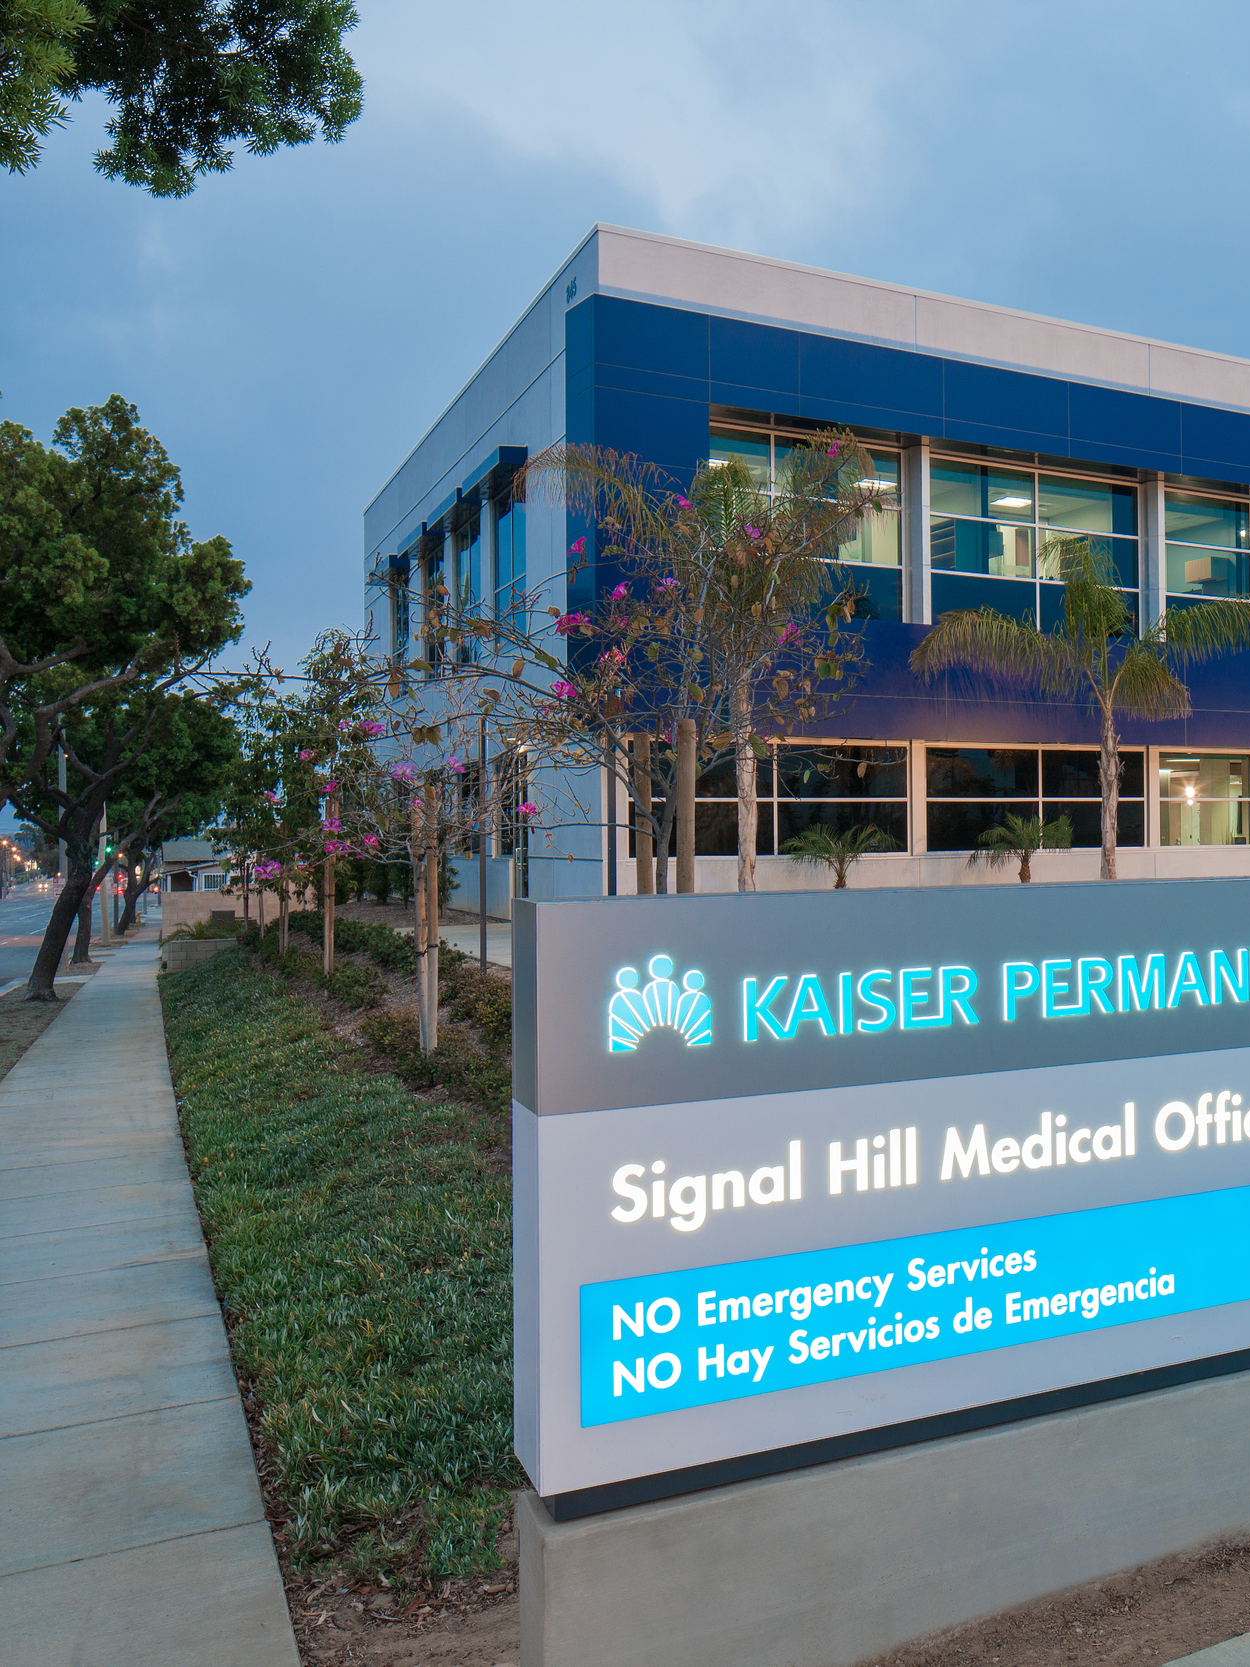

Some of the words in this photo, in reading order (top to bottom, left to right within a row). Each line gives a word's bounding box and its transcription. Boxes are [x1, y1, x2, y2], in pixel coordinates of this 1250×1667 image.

[566, 275, 577, 304] 845
[742, 964, 981, 1042] KAISER
[610, 1138, 802, 1232] Signal
[828, 1126, 917, 1195] Hill
[940, 1101, 1136, 1181] Medical
[612, 1297, 681, 1341] NO
[697, 1272, 894, 1327] Emergency
[906, 1246, 1038, 1292] Services
[613, 1352, 682, 1397] NO
[698, 1344, 775, 1383] Hay
[788, 1312, 940, 1365] Servicios
[952, 1297, 993, 1334] de
[1005, 1266, 1175, 1320] Emergencia
